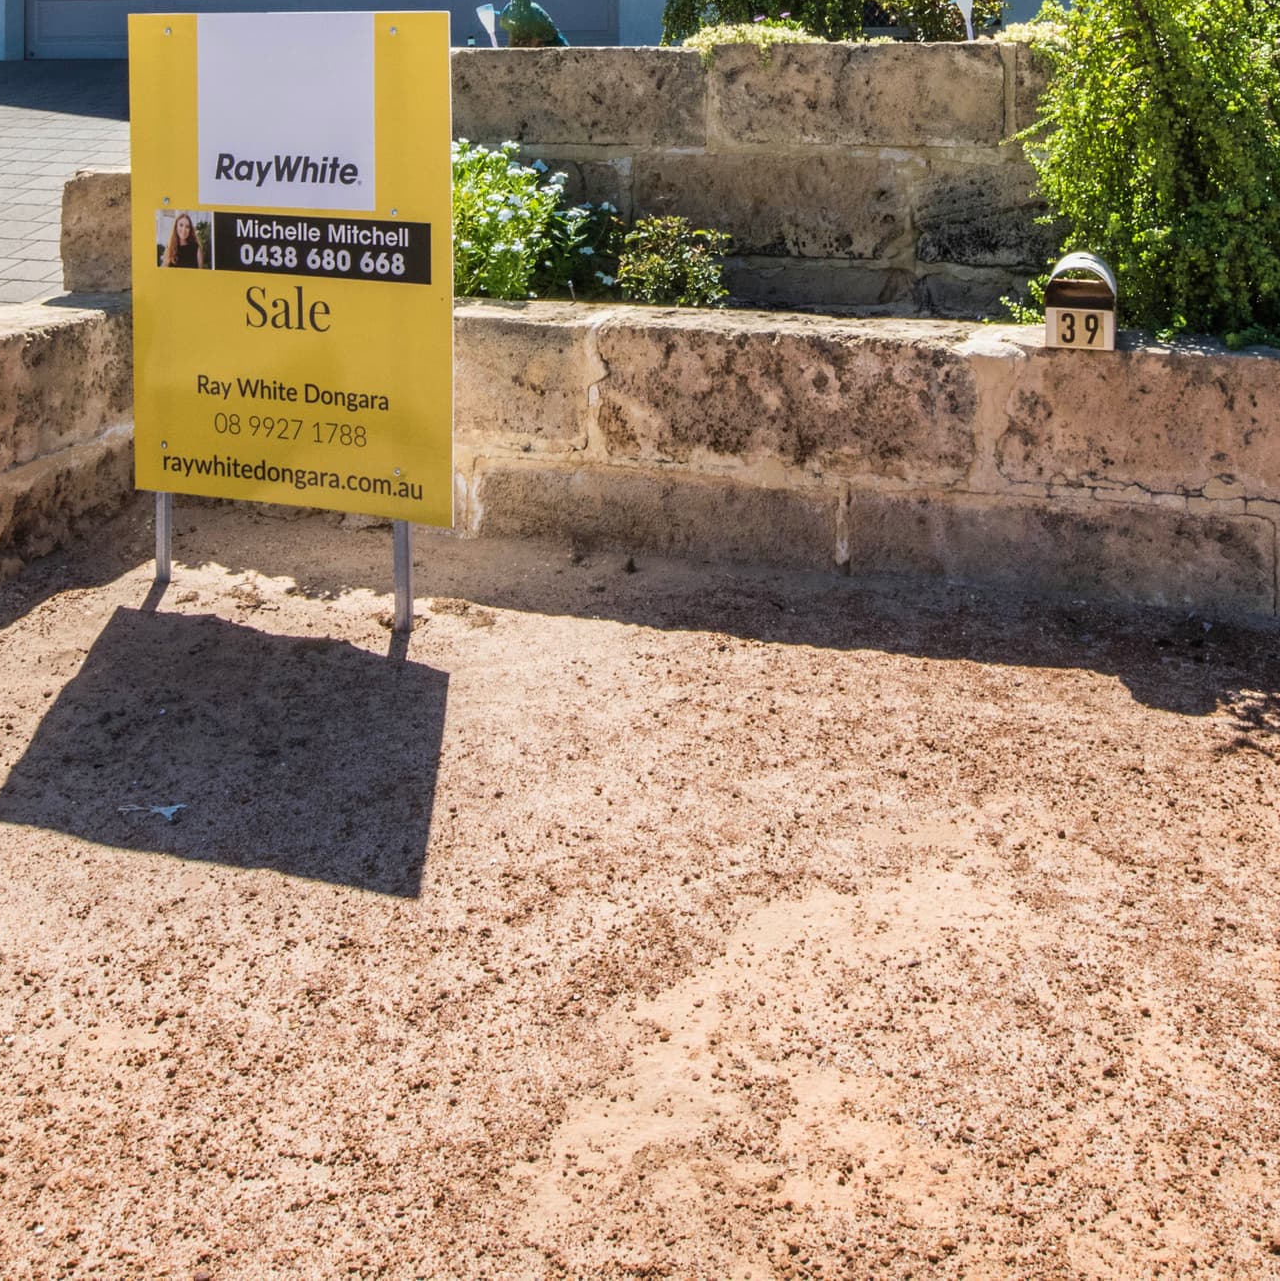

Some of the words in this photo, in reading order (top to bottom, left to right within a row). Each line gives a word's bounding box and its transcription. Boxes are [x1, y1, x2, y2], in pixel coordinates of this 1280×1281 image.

[236, 219, 321, 242] Michelle
[328, 225, 409, 247] Mitchell
[240, 244, 297, 268] 0438
[307, 248, 351, 271] 680
[360, 252, 405, 275] 668
[245, 286, 331, 333] Sale
[1061, 313, 1099, 344] 39
[197, 375, 231, 401] Ray
[237, 378, 297, 403] White
[304, 383, 389, 411] Dongara
[214, 412, 241, 435] 08
[249, 415, 303, 440] 9927
[312, 422, 367, 447] 1788
[163, 452, 423, 500] raywhitedongara.com.au
